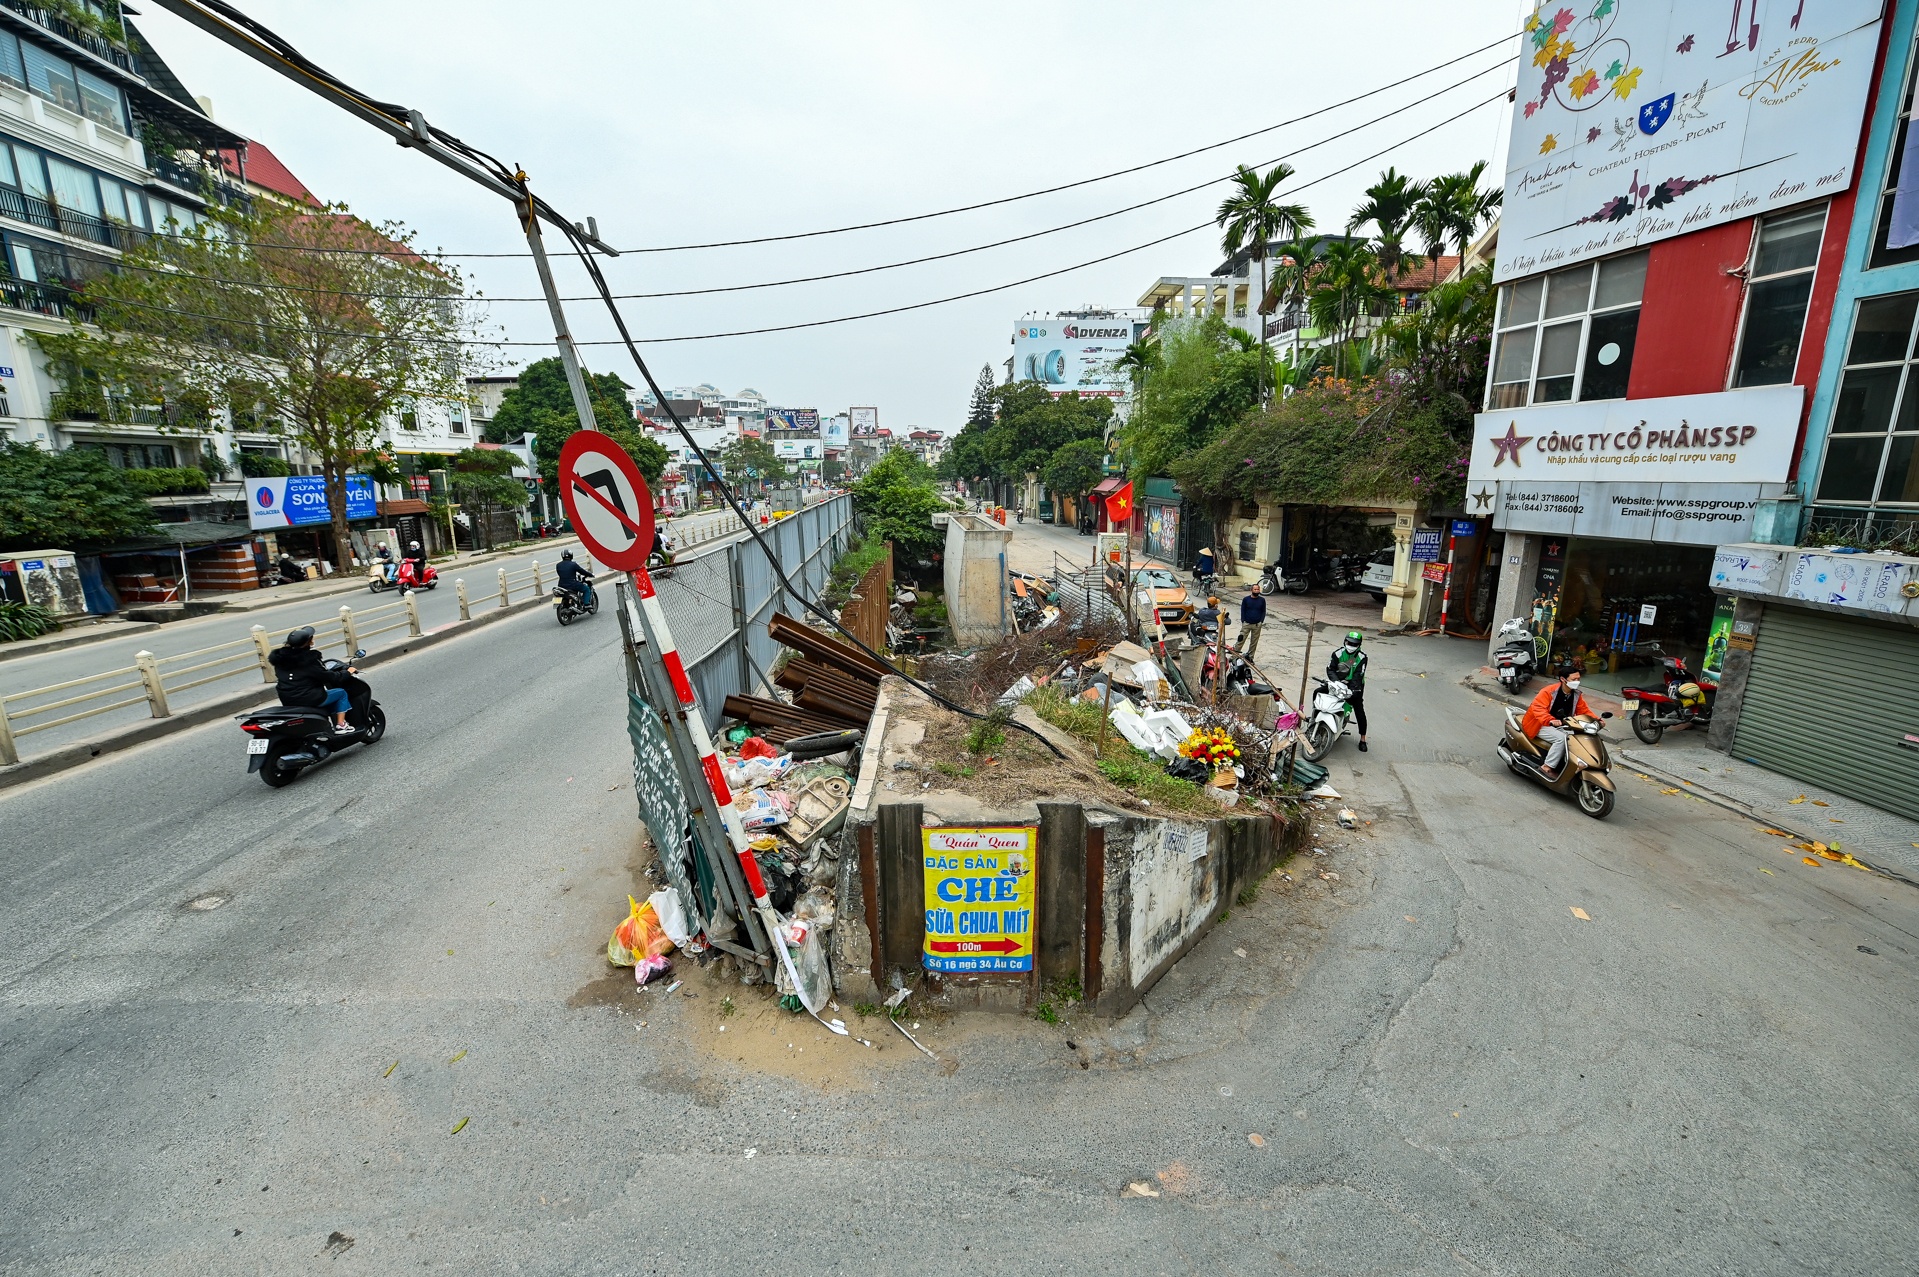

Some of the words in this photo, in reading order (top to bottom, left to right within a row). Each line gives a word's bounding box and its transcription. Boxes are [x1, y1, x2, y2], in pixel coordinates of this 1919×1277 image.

[1763, 48, 1781, 66] SAN
[1788, 36, 1819, 47] PEDRO
[1760, 82, 1809, 105] CACHAPOAL
[1588, 156, 1631, 177] CHATEAU
[1515, 161, 1584, 197] Anakena
[1769, 179, 1808, 200] đam
[1816, 166, 1847, 188] mê
[1065, 325, 1128, 339] ADVENZA
[768, 409, 797, 417] Dr.Care
[1536, 430, 1584, 452] CÔNG
[1587, 432, 1613, 451] TY
[1613, 419, 1647, 450] CỔ
[1547, 454, 1567, 466] Nhập
[1623, 451, 1640, 466] cấp
[1641, 453, 1658, 464] các
[1659, 452, 1677, 465] loại
[1678, 453, 1706, 465] rượu
[1709, 452, 1737, 465] vang
[292, 492, 325, 506] SƠN
[1505, 493, 1517, 502] Tel:
[1518, 492, 1539, 503] (844)
[1541, 493, 1580, 503] 37186001
[1612, 495, 1655, 507] Website:
[1521, 503, 1543, 513] (844)
[1543, 504, 1584, 515] 37186002
[1621, 507, 1651, 519] Email:
[1415, 532, 1440, 545] HOTEL
[1738, 623, 1749, 633] 32
[988, 836, 1019, 848] Quen
[925, 856, 959, 872] ĐẶC
[964, 854, 998, 870] SẢN
[936, 872, 1019, 904] CHÈ
[925, 907, 955, 935] SỮA
[958, 911, 999, 935] CHUA
[1003, 907, 1030, 934] MÍT
[956, 942, 982, 952] 100m
[929, 957, 942, 968] Số
[959, 958, 977, 970] ngõ
[979, 960, 992, 969] 34
[994, 957, 1007, 969] Âu
[1009, 958, 1023, 969] Cơ
